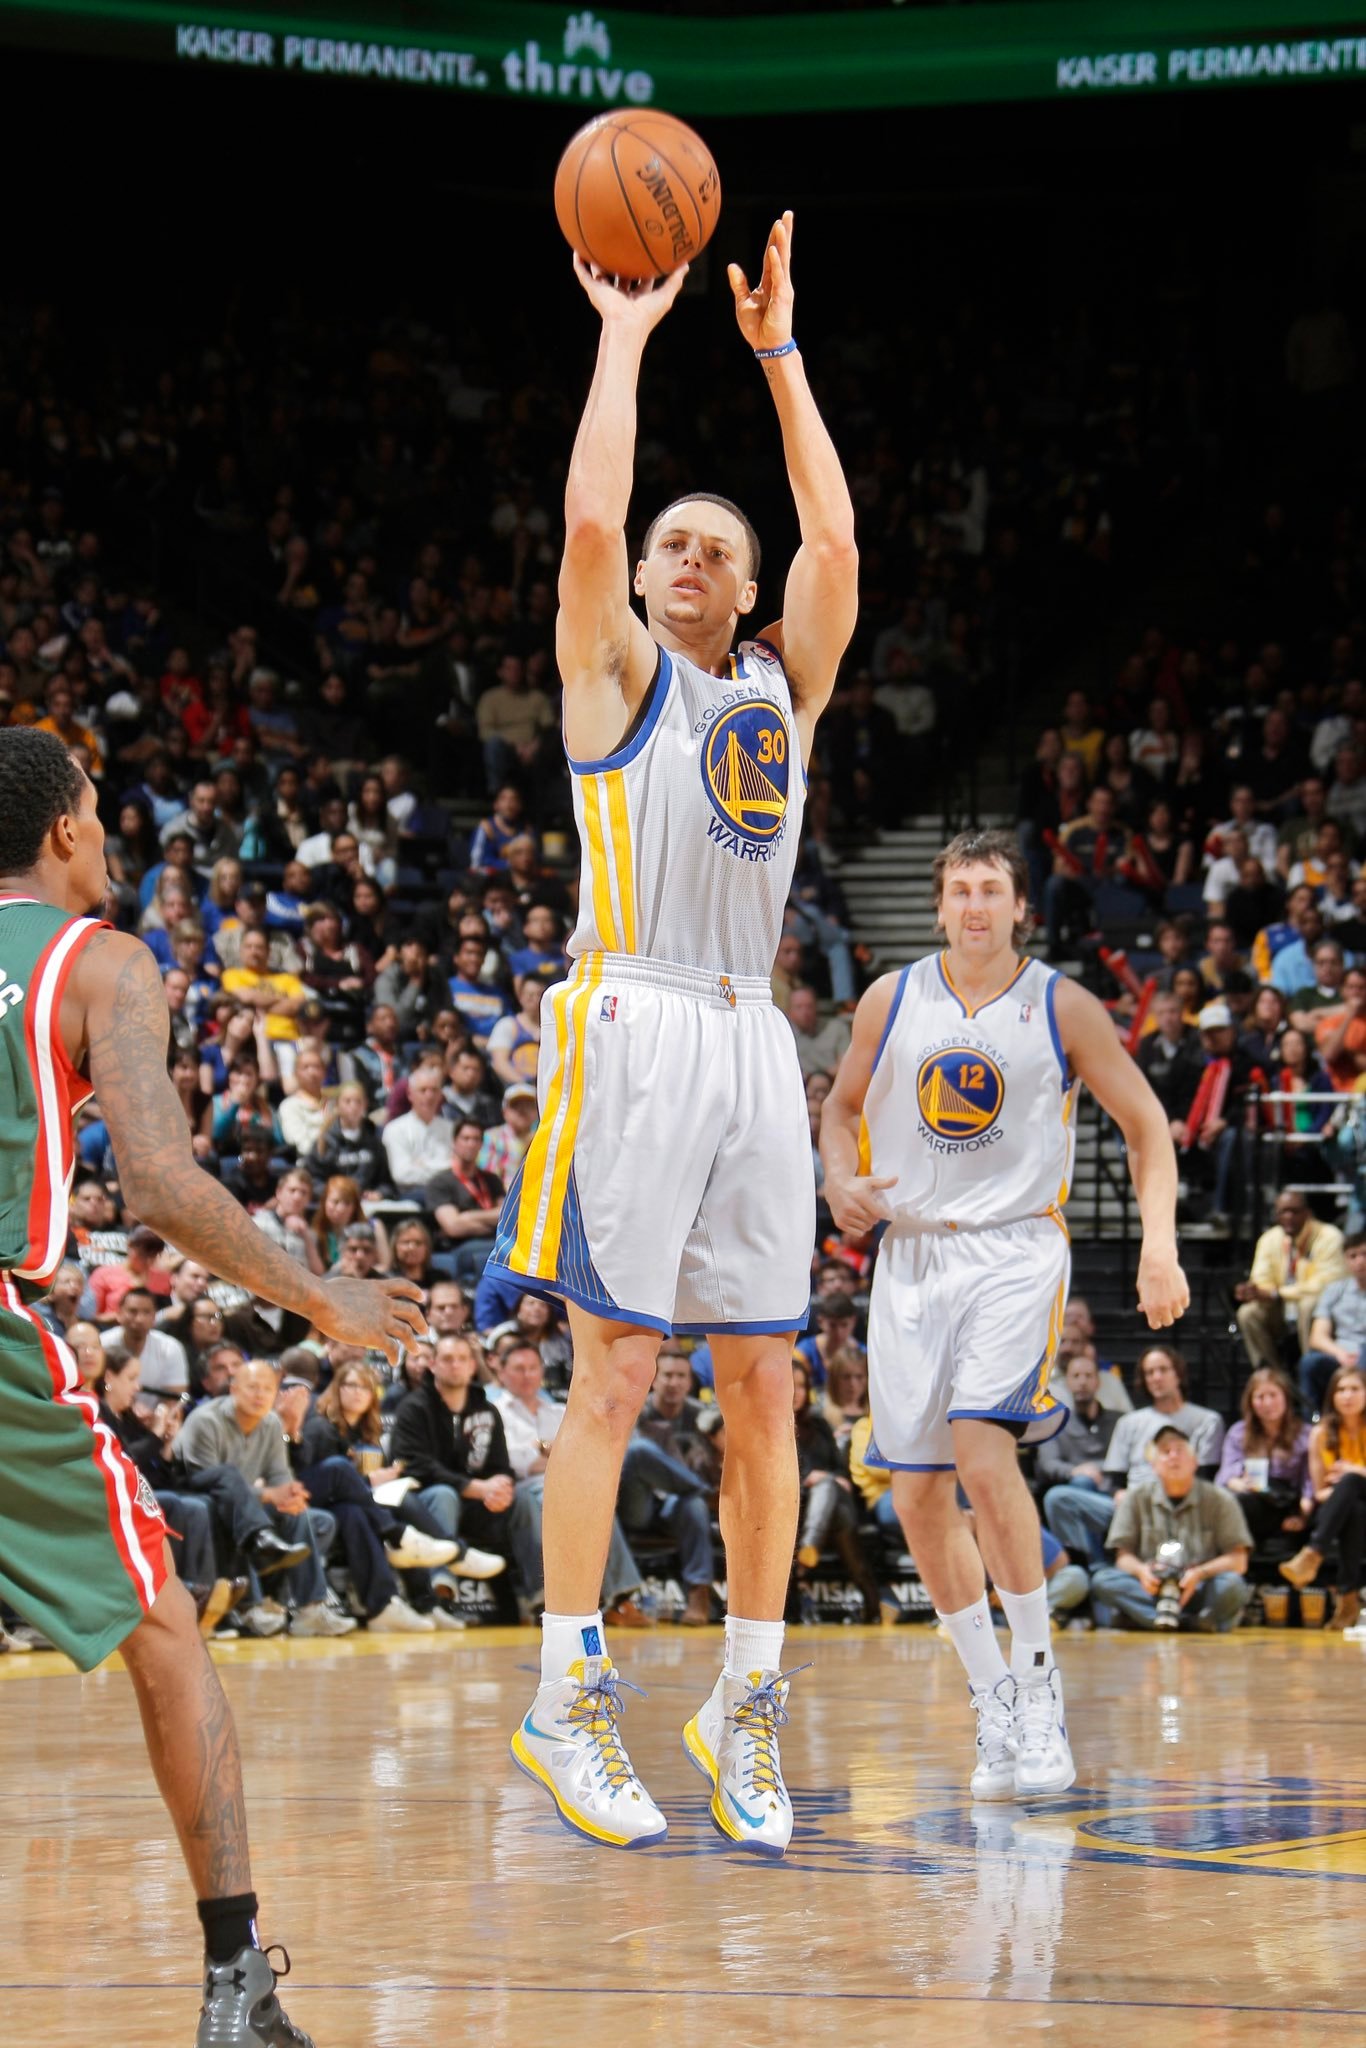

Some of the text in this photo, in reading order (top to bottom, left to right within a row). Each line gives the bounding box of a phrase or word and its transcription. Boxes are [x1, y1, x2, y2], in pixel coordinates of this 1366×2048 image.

[176, 25, 275, 65] KAISER
[503, 41, 653, 102] thrive
[1057, 52, 1157, 89] KAISER
[695, 687, 761, 734] GOLDEN
[757, 729, 785, 764] 30
[916, 1037, 1010, 1072] GOLDEN STATE
[959, 1064, 986, 1089] 12
[917, 1120, 1004, 1154] WARRIORS
[890, 1583, 931, 1603] VIS
